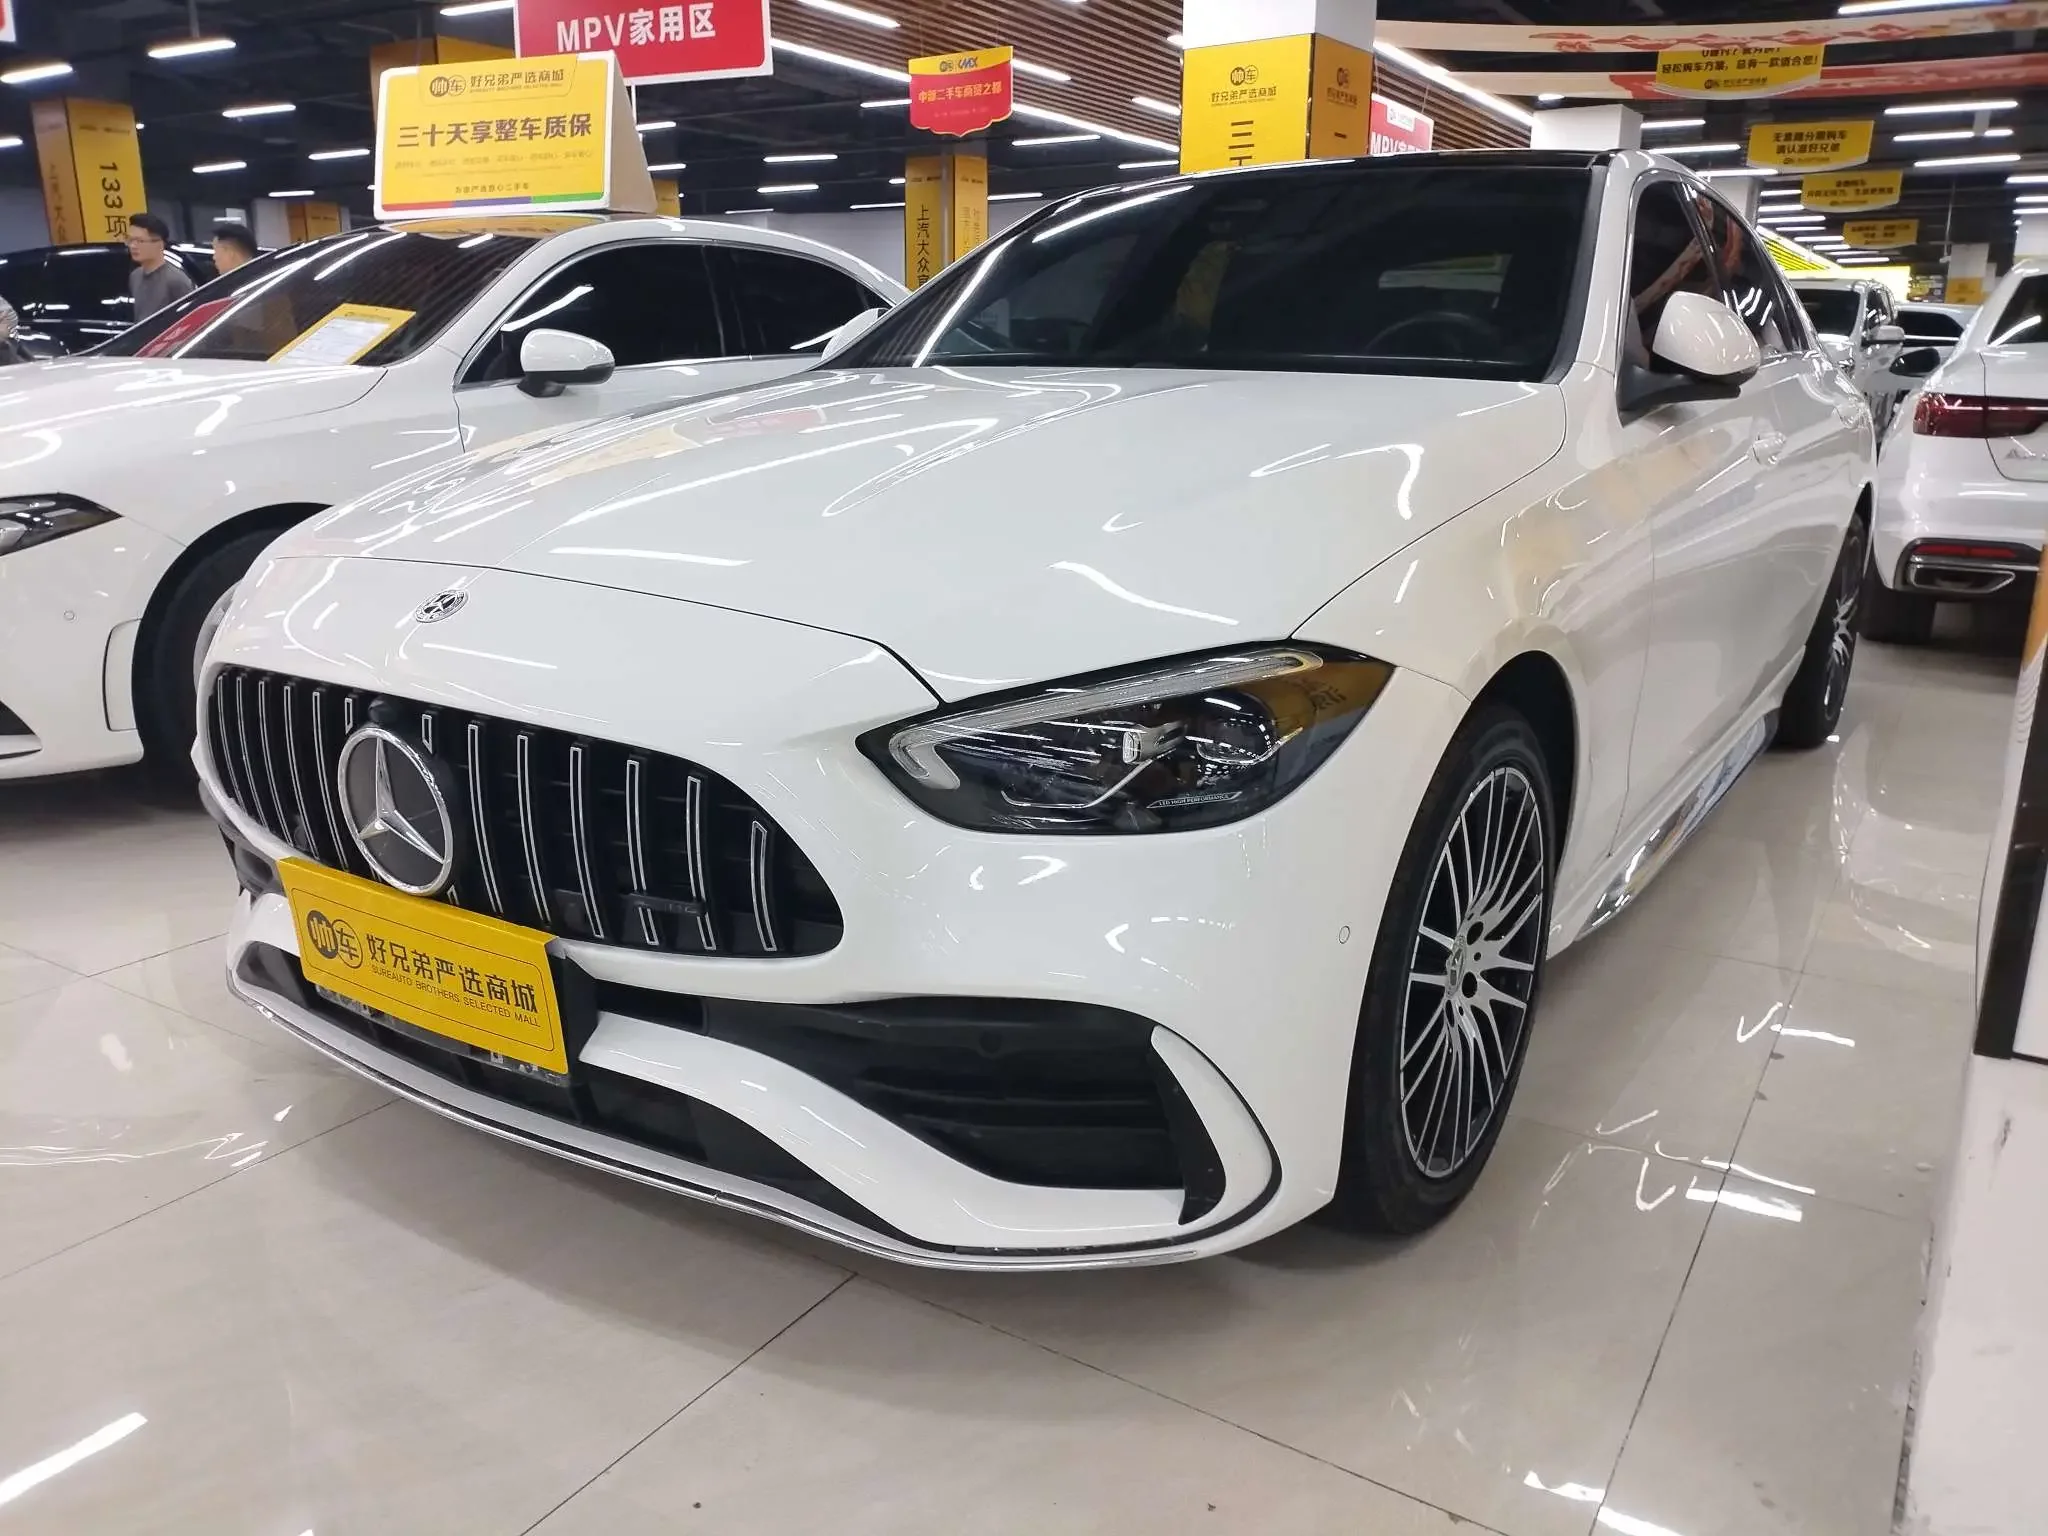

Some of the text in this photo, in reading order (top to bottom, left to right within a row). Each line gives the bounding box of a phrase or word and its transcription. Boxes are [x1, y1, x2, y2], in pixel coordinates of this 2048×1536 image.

[557, 2, 716, 52] MPV家用区
[470, 68, 564, 88] 好兄弟严选商城
[1211, 86, 1277, 103] 好兄弟严选商城
[397, 113, 592, 148] 三十天享整车质保
[366, 934, 539, 1013] 好兄弟严选商城
[372, 966, 541, 1028] SUREAUTO BROTHERS SELECTED MALL
